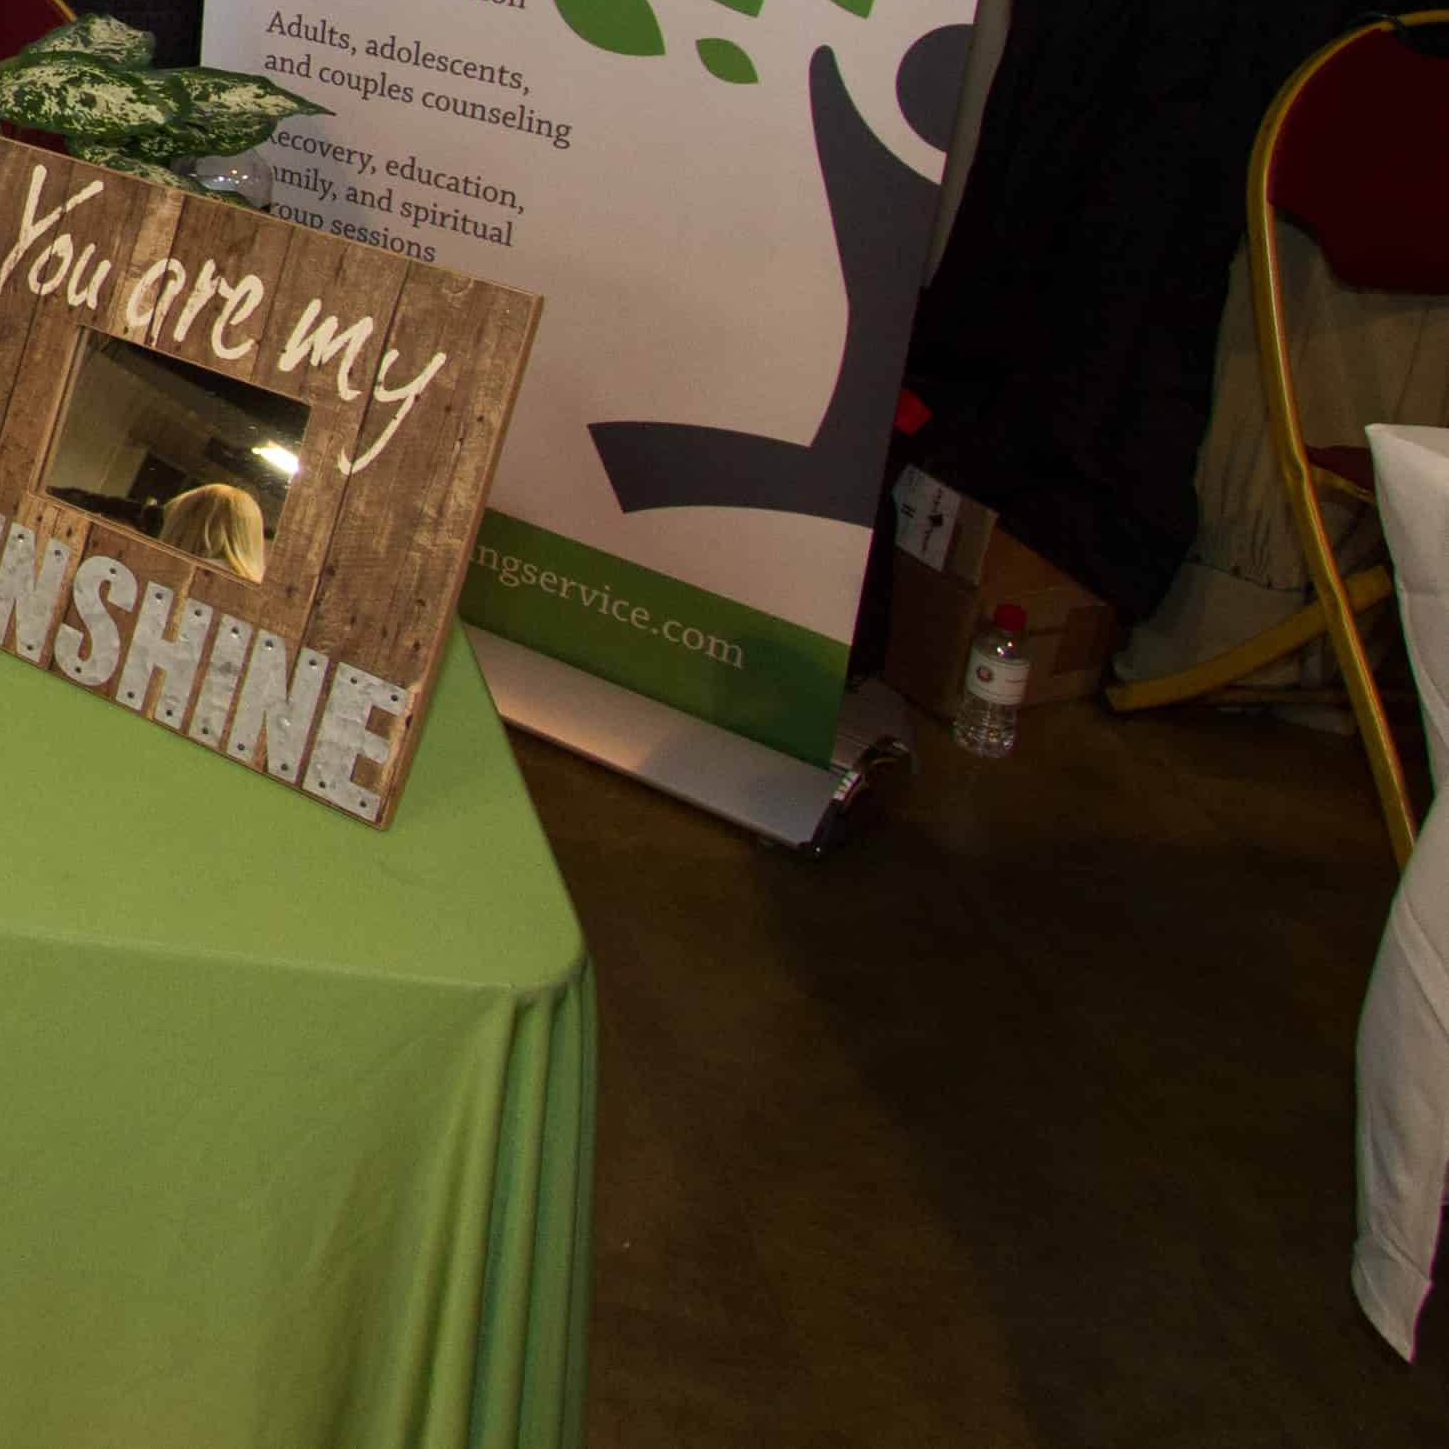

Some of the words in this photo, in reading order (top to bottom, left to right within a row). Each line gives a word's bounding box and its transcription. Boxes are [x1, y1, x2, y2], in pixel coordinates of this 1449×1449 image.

[264, 9, 359, 57] Adults,
[363, 34, 531, 97] adolescents,
[263, 51, 313, 80] and
[317, 63, 415, 104] couples
[420, 90, 573, 150] counseling
[345, 182, 394, 215] and
[399, 195, 515, 248] spiritual
[384, 155, 526, 216] education,
[329, 218, 438, 264] sessions
[124, 256, 264, 362] are
[276, 297, 447, 476] my
[467, 542, 748, 672] ngservice.com
